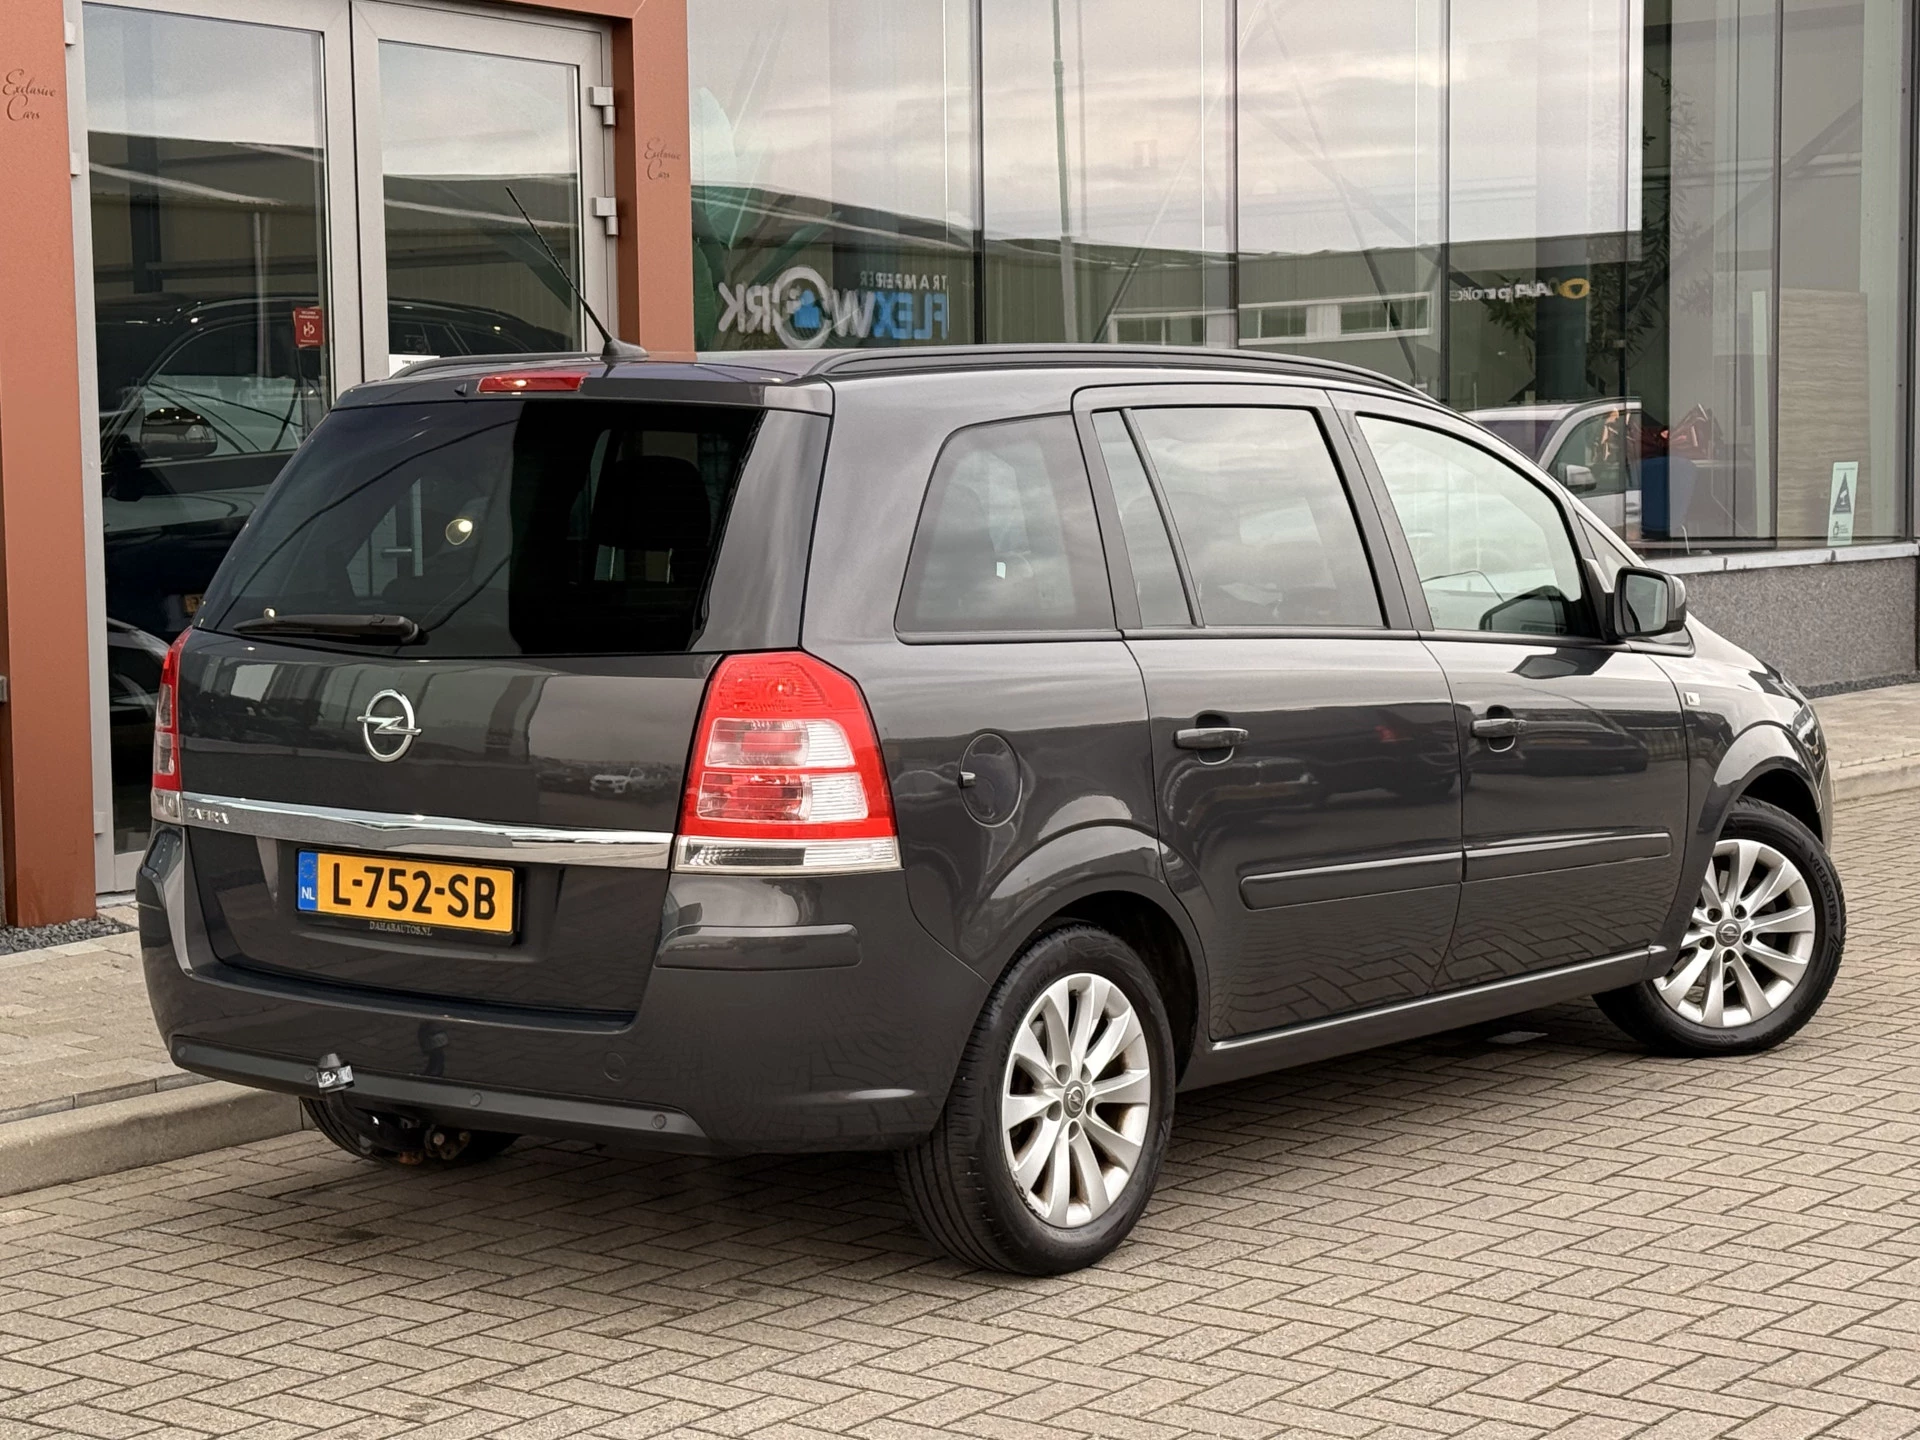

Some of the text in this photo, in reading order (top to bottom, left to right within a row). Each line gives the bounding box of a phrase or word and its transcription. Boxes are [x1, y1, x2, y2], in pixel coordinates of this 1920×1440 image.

[2, 68, 56, 98] Exclusive
[6, 93, 40, 121] Cars
[187, 807, 230, 825] ZAFIRA
[301, 886, 316, 901] NL
[332, 862, 496, 921] L-752-SB
[1809, 851, 1838, 927] VREDESTEIN
